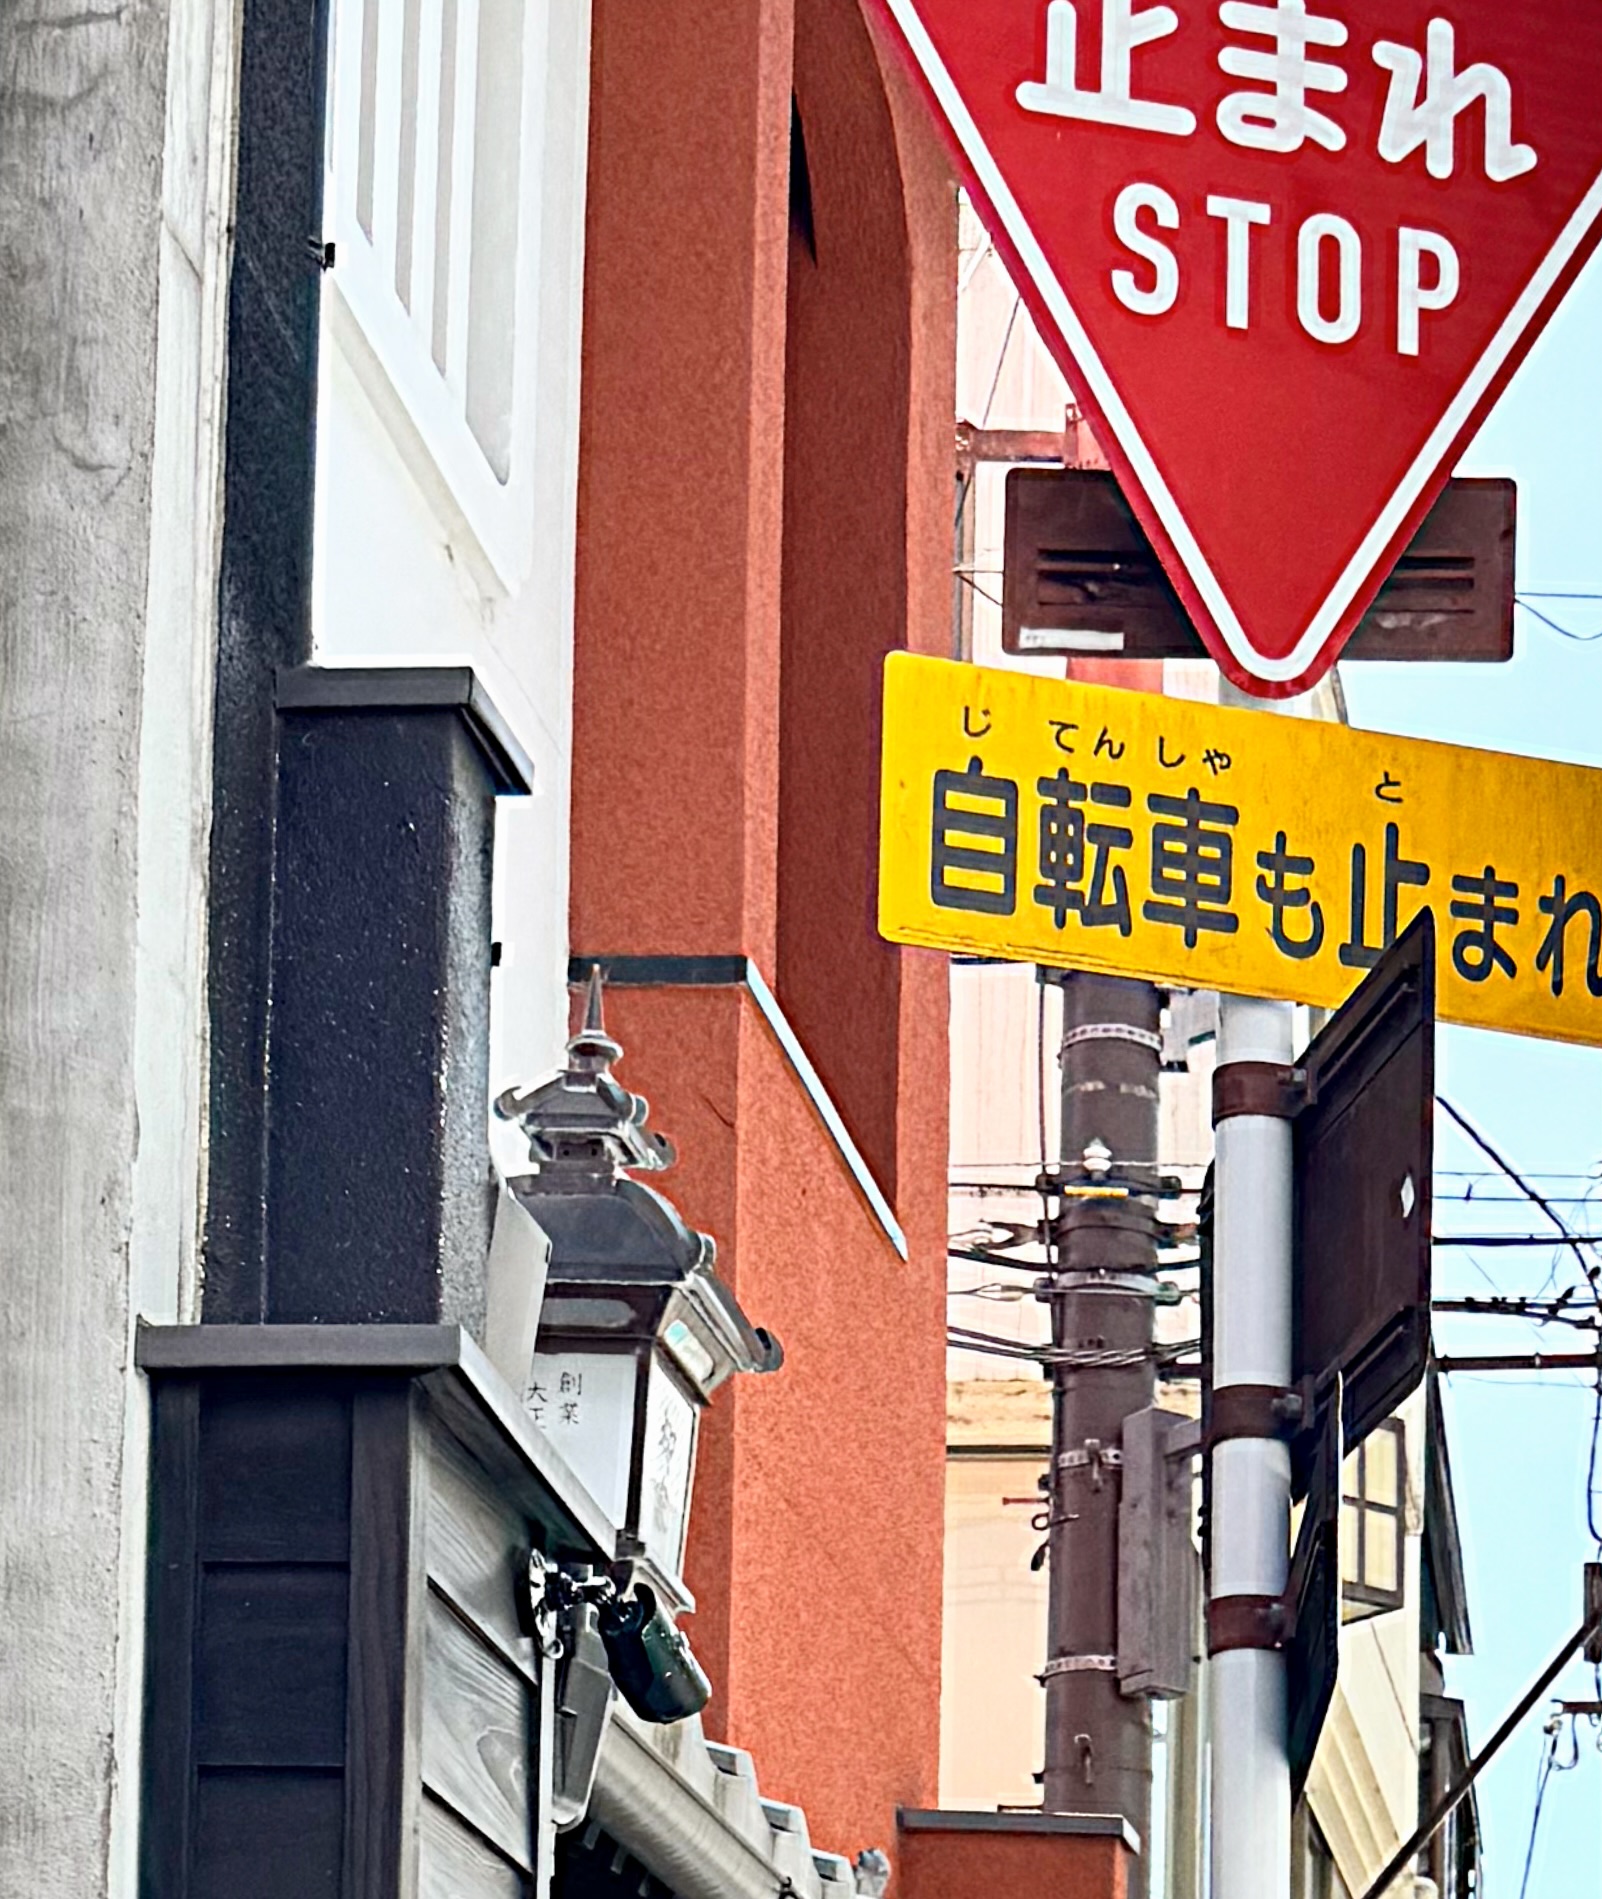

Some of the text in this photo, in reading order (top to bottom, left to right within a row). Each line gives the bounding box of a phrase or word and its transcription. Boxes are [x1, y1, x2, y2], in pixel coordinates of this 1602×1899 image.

[1015, 0, 1538, 182] 止まれ
[1111, 182, 1460, 356] STOP
[560, 1372, 582, 1424] 創業
